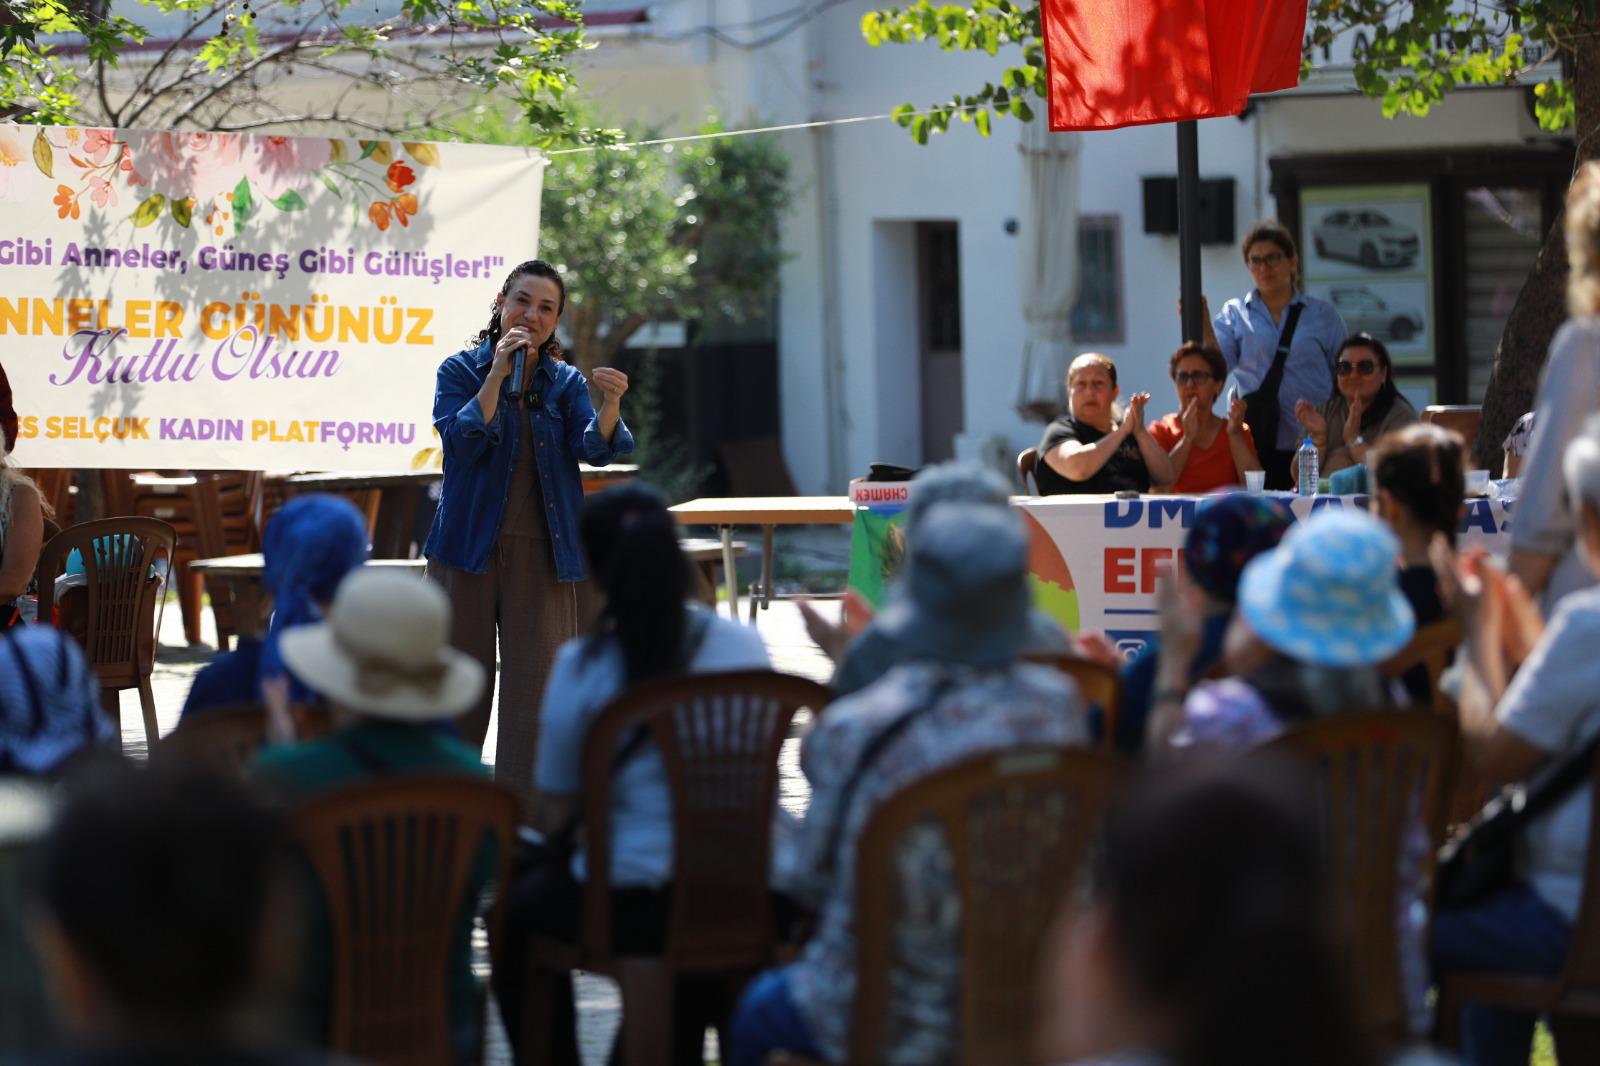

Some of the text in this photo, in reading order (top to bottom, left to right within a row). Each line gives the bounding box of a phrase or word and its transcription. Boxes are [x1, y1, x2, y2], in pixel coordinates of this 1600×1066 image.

[0, 237, 504, 284] Gibi Anneler, Güneş Gibi Gülüşler!"
[0, 291, 434, 345] NNELER GÜNÜNÜZ
[49, 325, 342, 386] Kutlu Olsun
[46, 416, 150, 443] SELÇUK
[160, 418, 244, 440] KADIN
[252, 420, 416, 451] PLATFORMU
